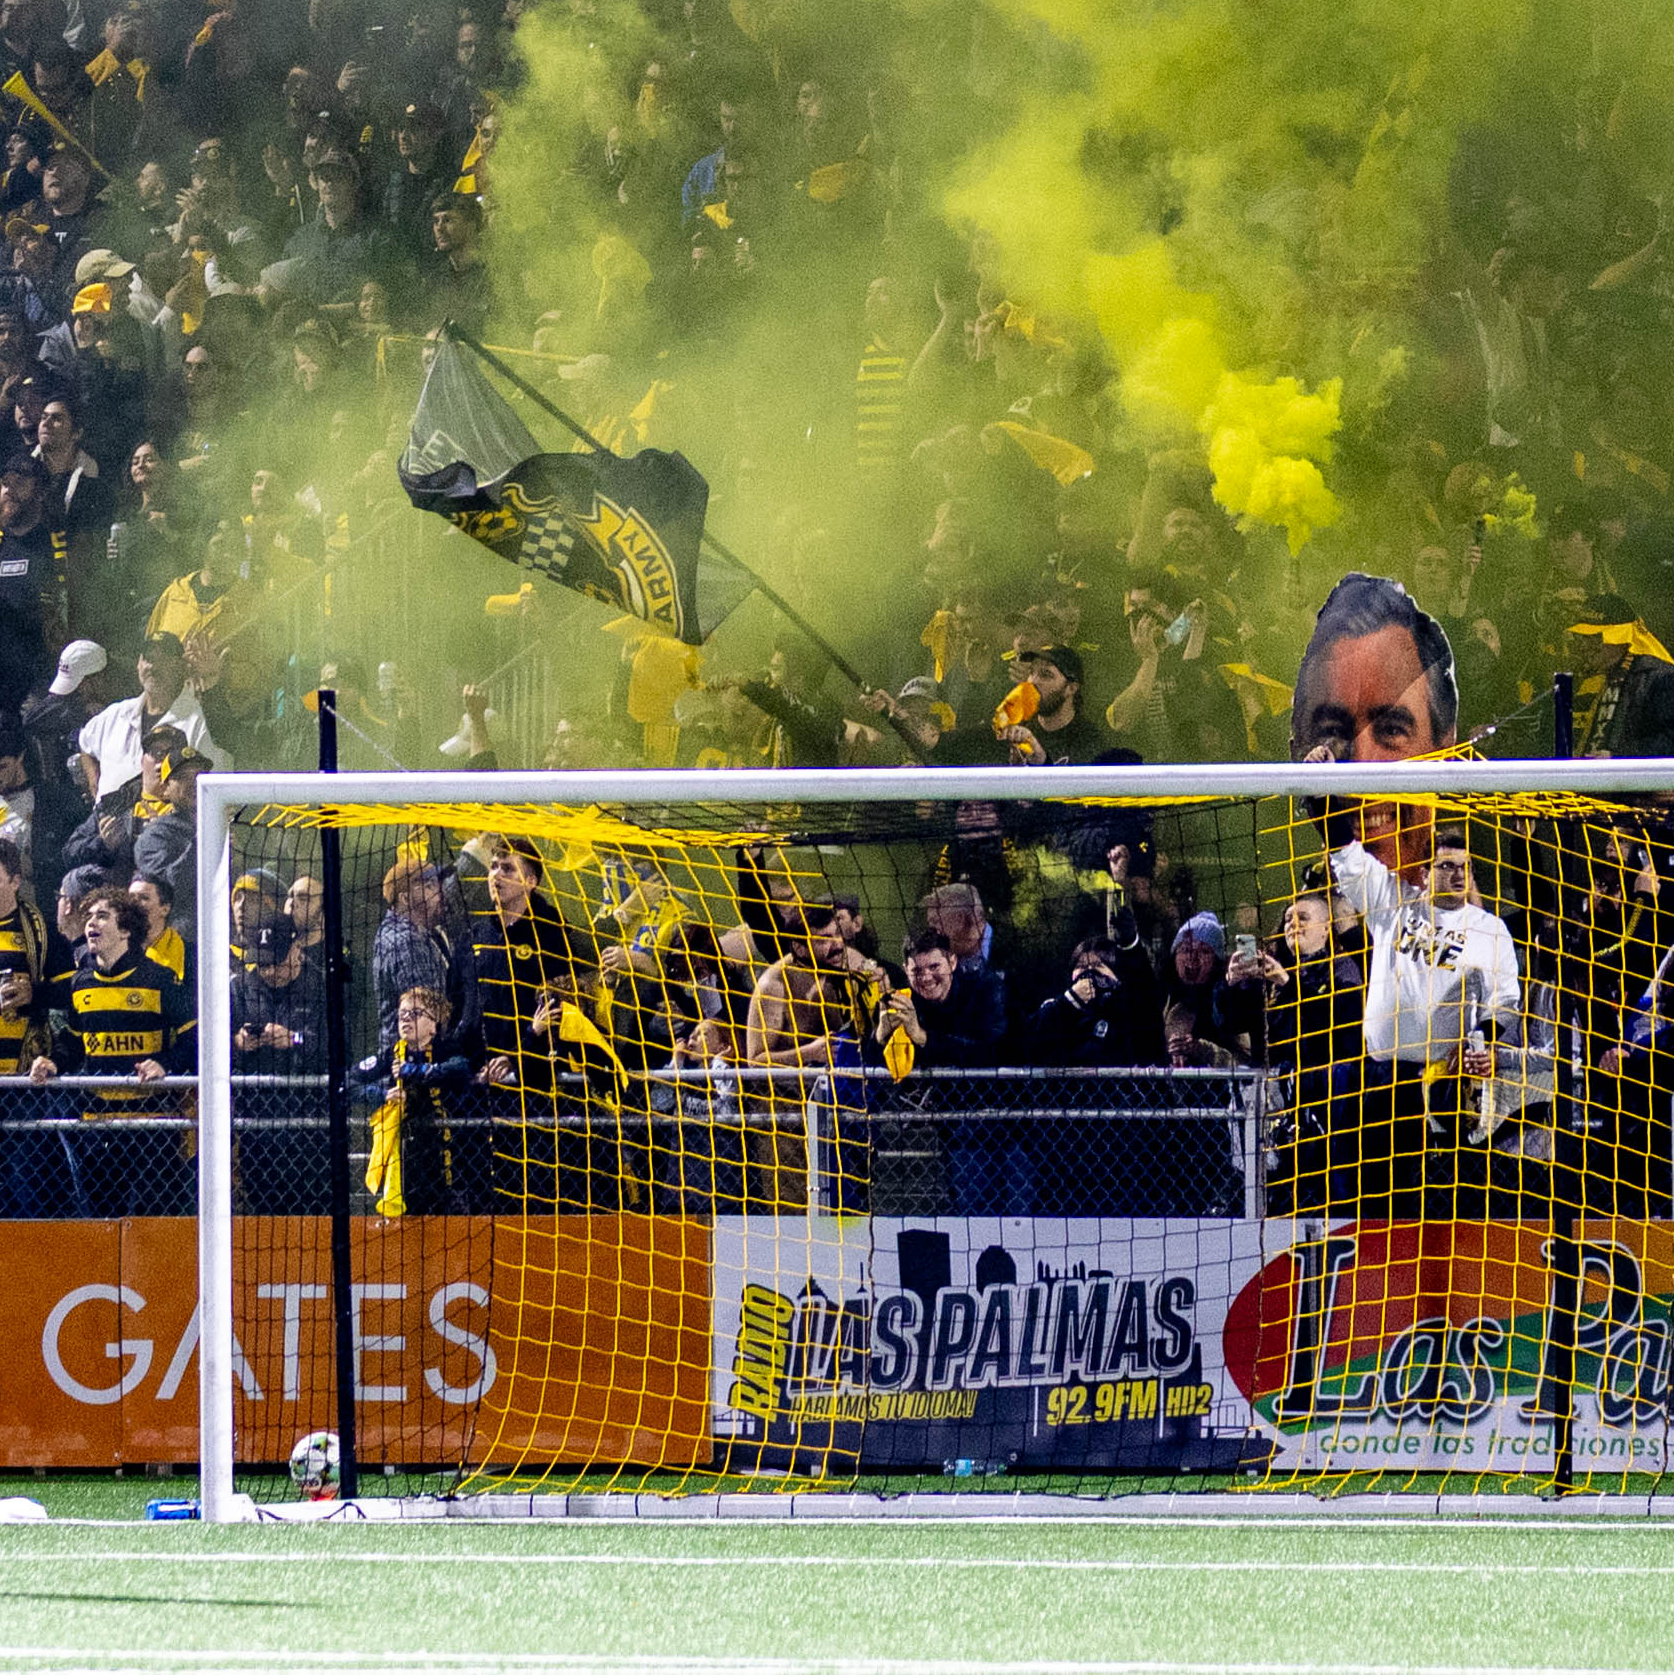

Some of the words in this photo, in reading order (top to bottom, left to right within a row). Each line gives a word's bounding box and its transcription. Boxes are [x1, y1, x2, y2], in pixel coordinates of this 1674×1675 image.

[619, 530, 677, 625] ARMY
[103, 1035, 144, 1053] AHN
[41, 1280, 499, 1406] GATES
[727, 1283, 796, 1422] RADIO
[787, 1291, 925, 1398] LAS
[927, 1274, 1204, 1392] PALMAS
[1272, 1234, 1504, 1423] Las
[1046, 1379, 1158, 1425] 92.9FM
[1320, 1424, 1421, 1456] donde
[1433, 1423, 1477, 1457] las
[1486, 1423, 1666, 1460] tradciones
